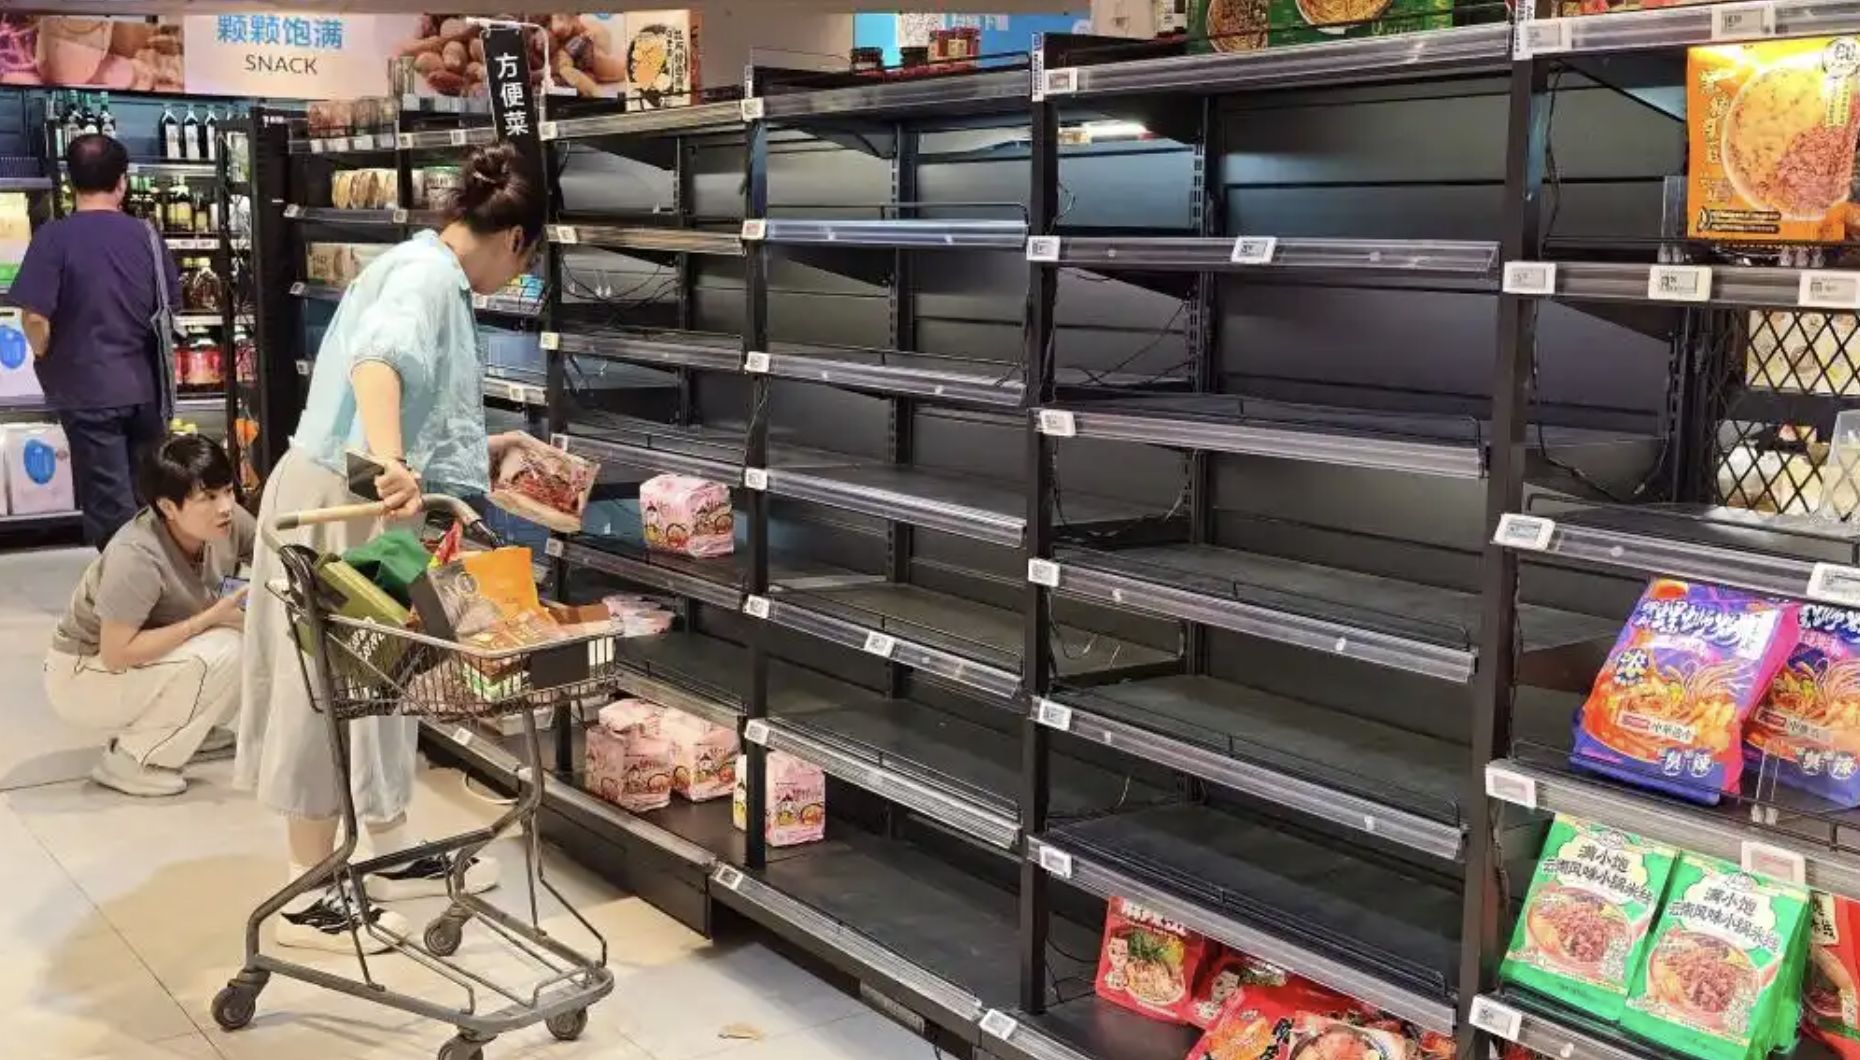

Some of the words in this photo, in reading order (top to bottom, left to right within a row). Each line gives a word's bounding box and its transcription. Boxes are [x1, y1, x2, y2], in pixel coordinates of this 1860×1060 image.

[217, 15, 344, 49] 颗颗饱满
[244, 54, 319, 75] SNACK
[494, 52, 529, 136] 方便菜
